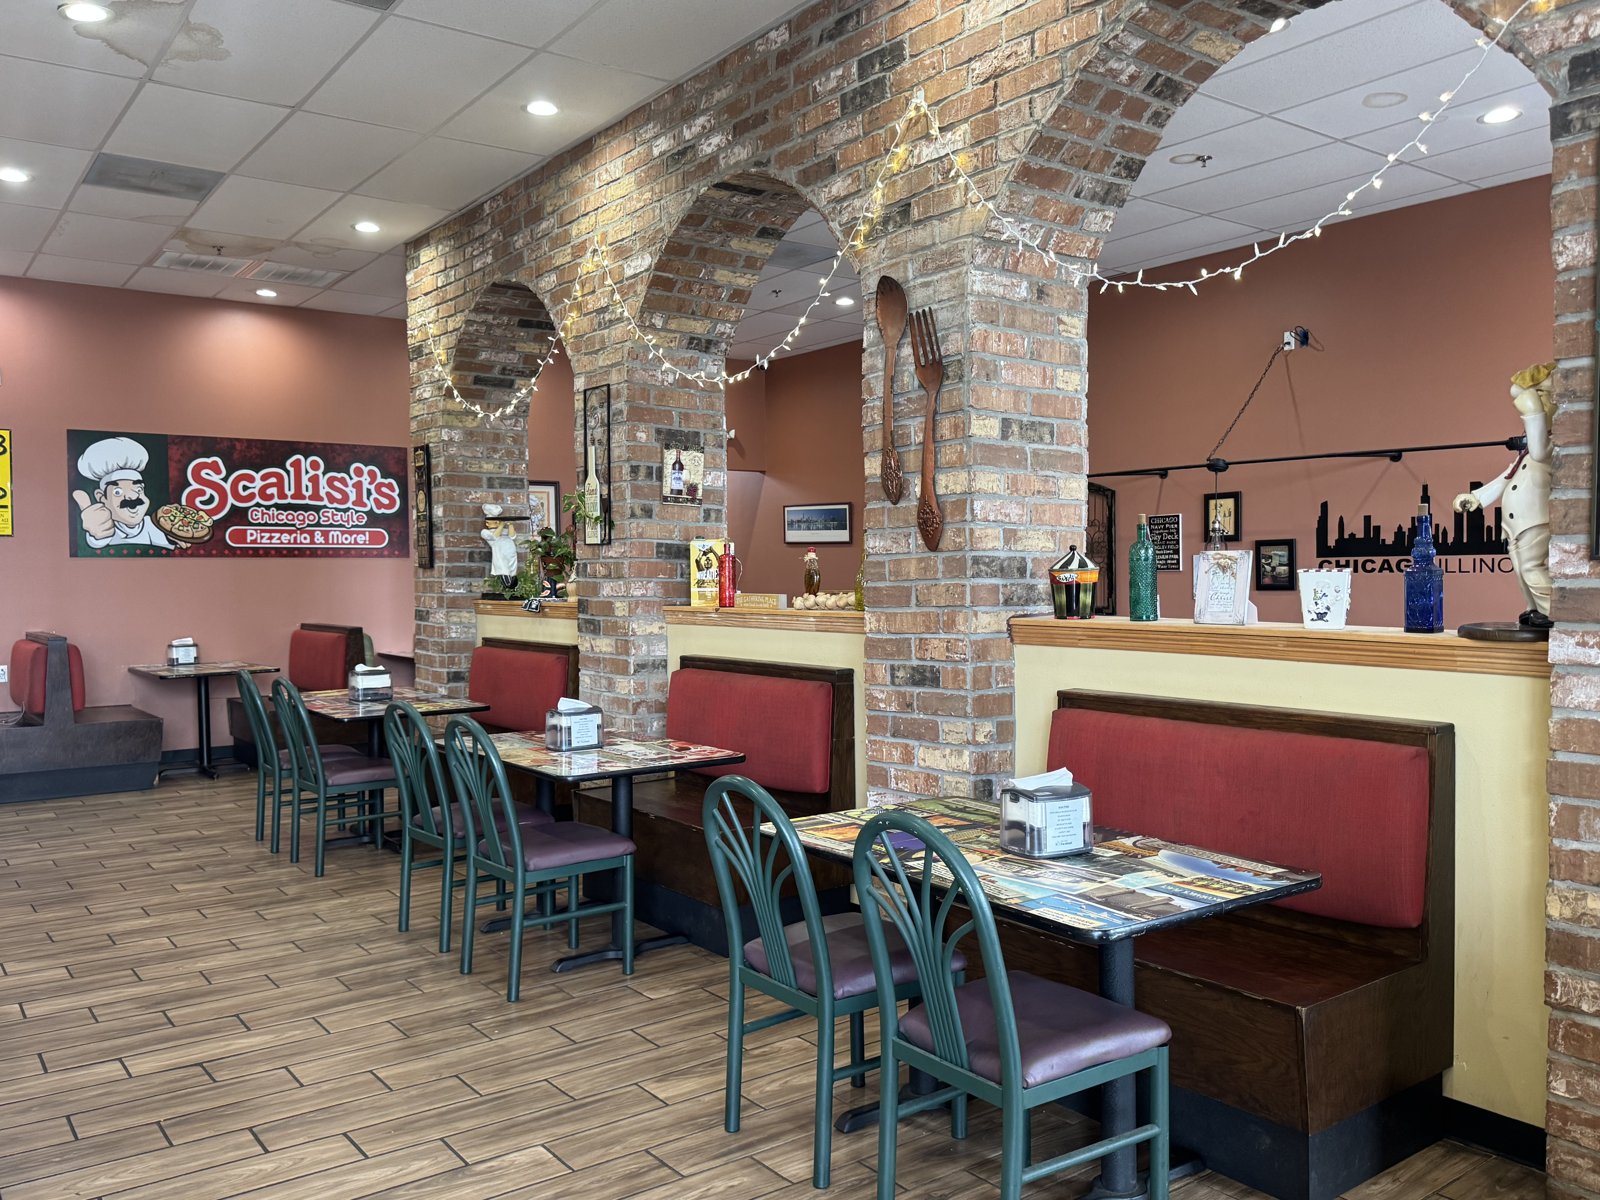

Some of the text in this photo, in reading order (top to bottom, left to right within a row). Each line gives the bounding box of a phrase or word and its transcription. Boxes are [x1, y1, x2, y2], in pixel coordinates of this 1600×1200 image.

[183, 455, 398, 520] Scalisi's
[250, 508, 367, 527] Chicago Style
[246, 529, 370, 545] Pizzeria & More!
[1317, 557, 1514, 574] CHICAG ILLINO
